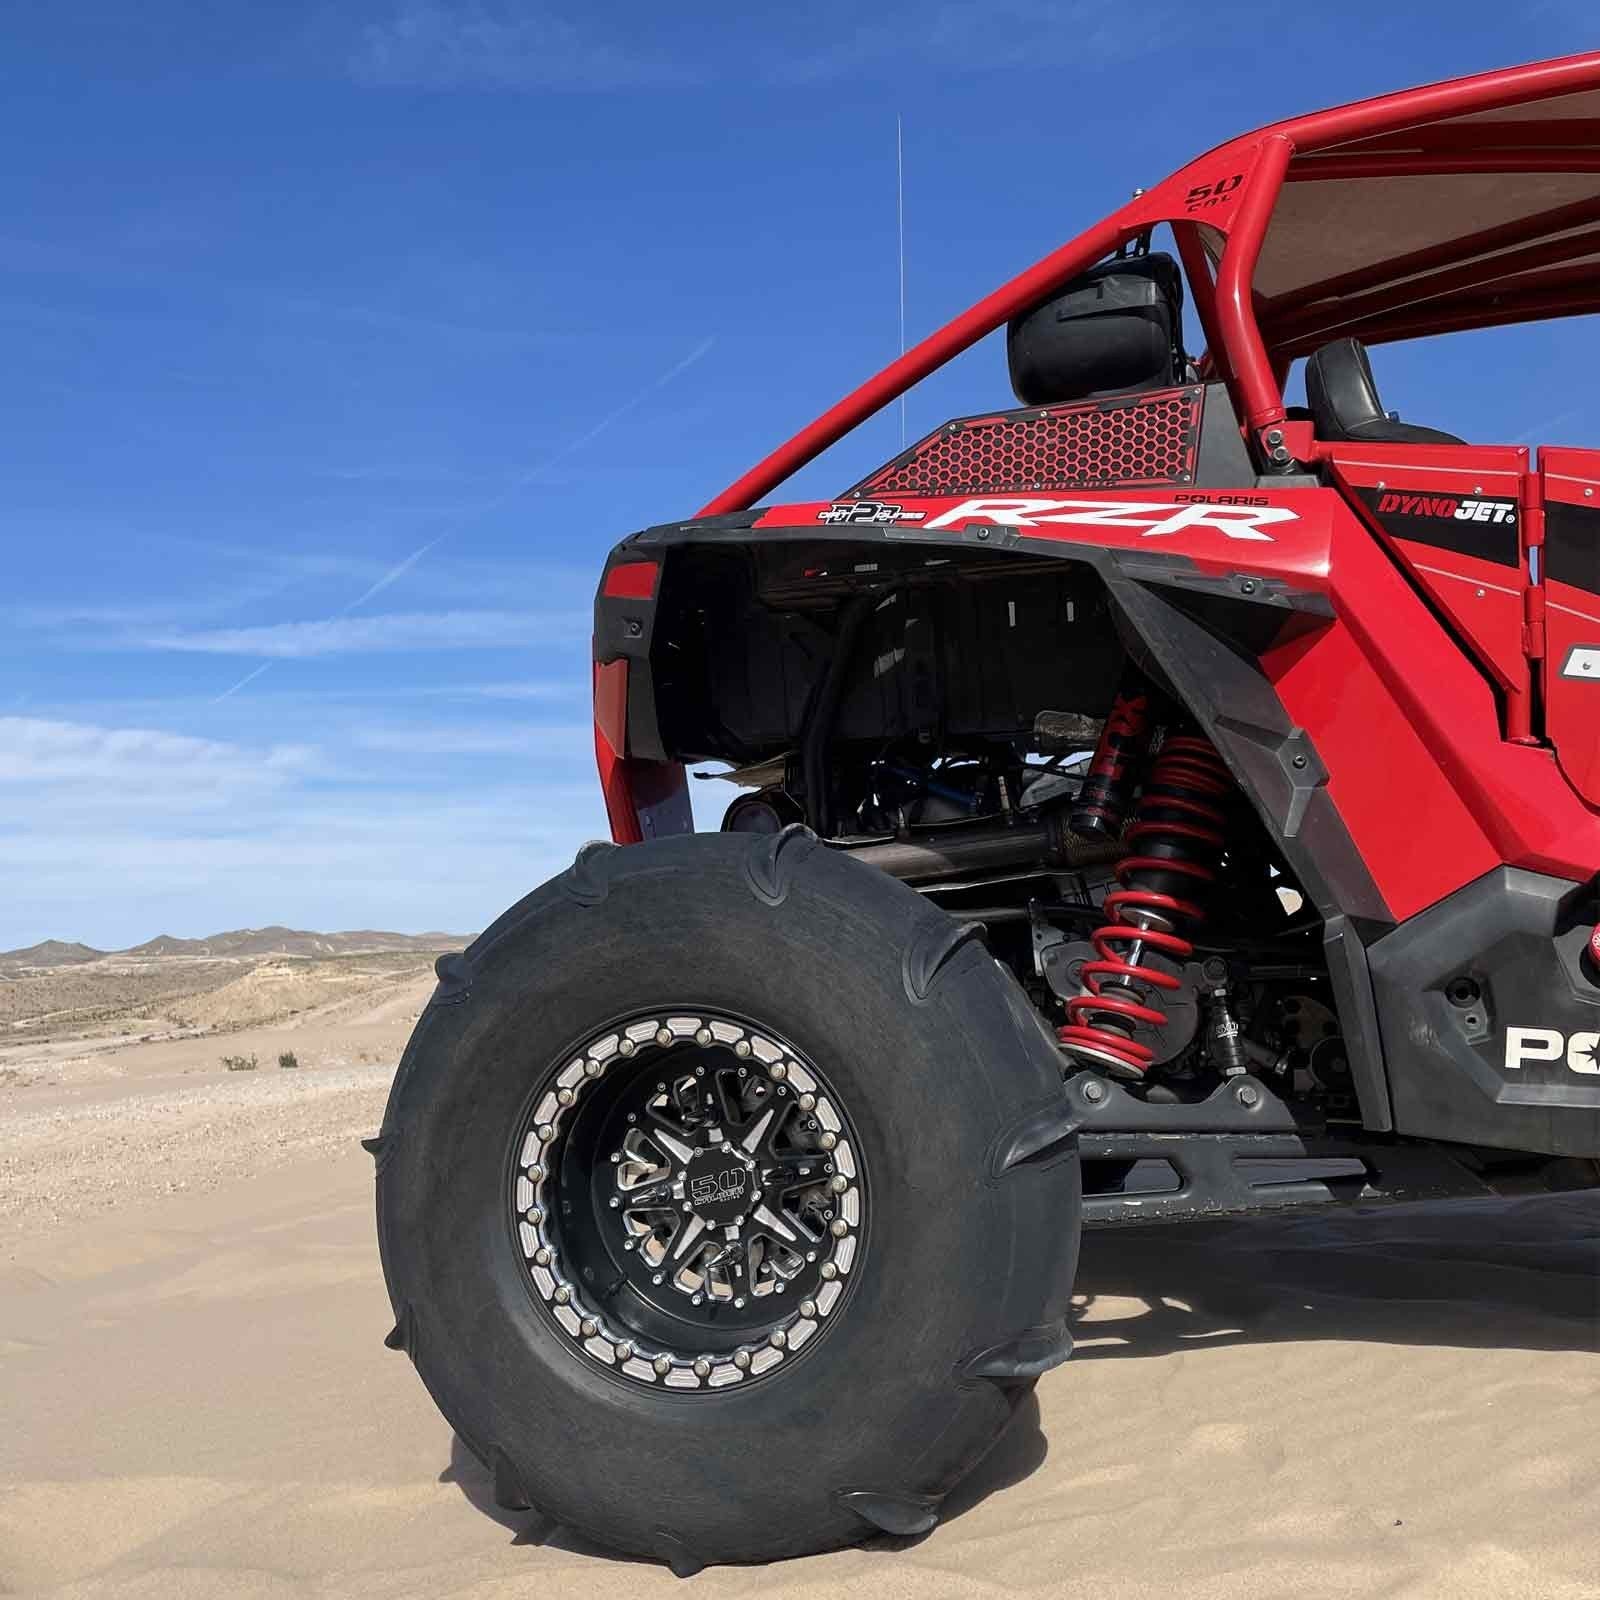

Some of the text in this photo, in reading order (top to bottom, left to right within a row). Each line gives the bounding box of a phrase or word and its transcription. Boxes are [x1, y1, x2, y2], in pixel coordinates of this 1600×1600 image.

[1184, 174, 1243, 204] 50
[1174, 494, 1269, 506] POLARIS
[923, 500, 1302, 541] RZR
[691, 1167, 746, 1200] 50
